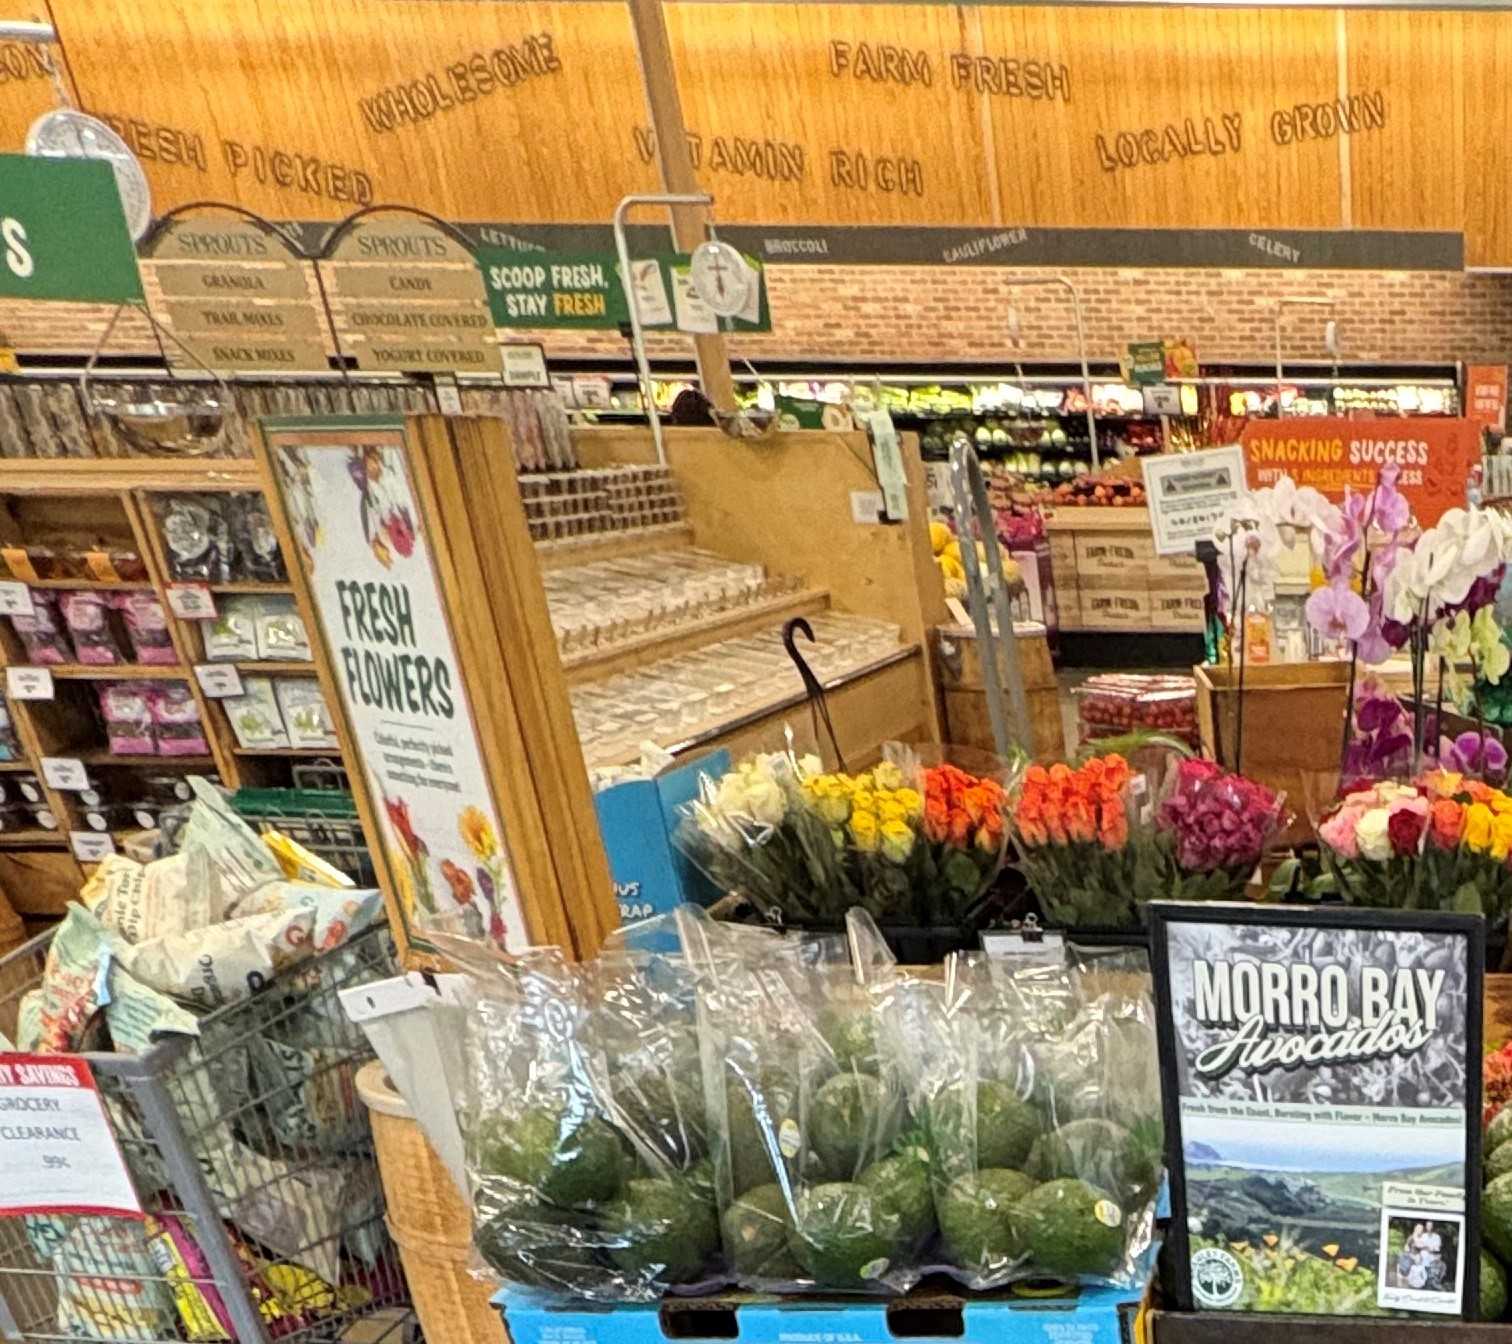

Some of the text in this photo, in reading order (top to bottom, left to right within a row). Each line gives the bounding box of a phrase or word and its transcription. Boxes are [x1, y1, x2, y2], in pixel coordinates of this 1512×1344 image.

[360, 34, 566, 134] WHOLESOME
[829, 40, 1072, 101] FARM FRESH
[1096, 90, 1386, 172] LOCALLY GROWN
[223, 138, 375, 205] PICKED
[632, 122, 924, 196] VTAMIN RICH
[178, 233, 265, 256] SPROUTS
[358, 235, 448, 257] SPROUTS
[764, 237, 830, 254] BROCCOLI
[942, 228, 1029, 263] CAULIFLOWER
[1248, 232, 1301, 264] CELERY
[389, 276, 433, 291] CANDY
[491, 264, 609, 291] SCOOP FRESH.
[506, 293, 606, 318] STAY FRESH
[429, 313, 488, 328] COVERED
[425, 350, 485, 364] COVERED
[1250, 438, 1429, 465] SNACKING SUCCESS
[335, 579, 417, 649] FRESH
[341, 646, 455, 720] FLOWERS
[1193, 959, 1447, 1030] MORRO BAY
[1198, 1010, 1434, 1074] Avocados
[15, 1063, 80, 1087] SAVINGS
[1314, 1111, 1333, 1121] with
[1335, 1111, 1363, 1122] Flavor
[0, 1125, 82, 1141] CLEARANCE
